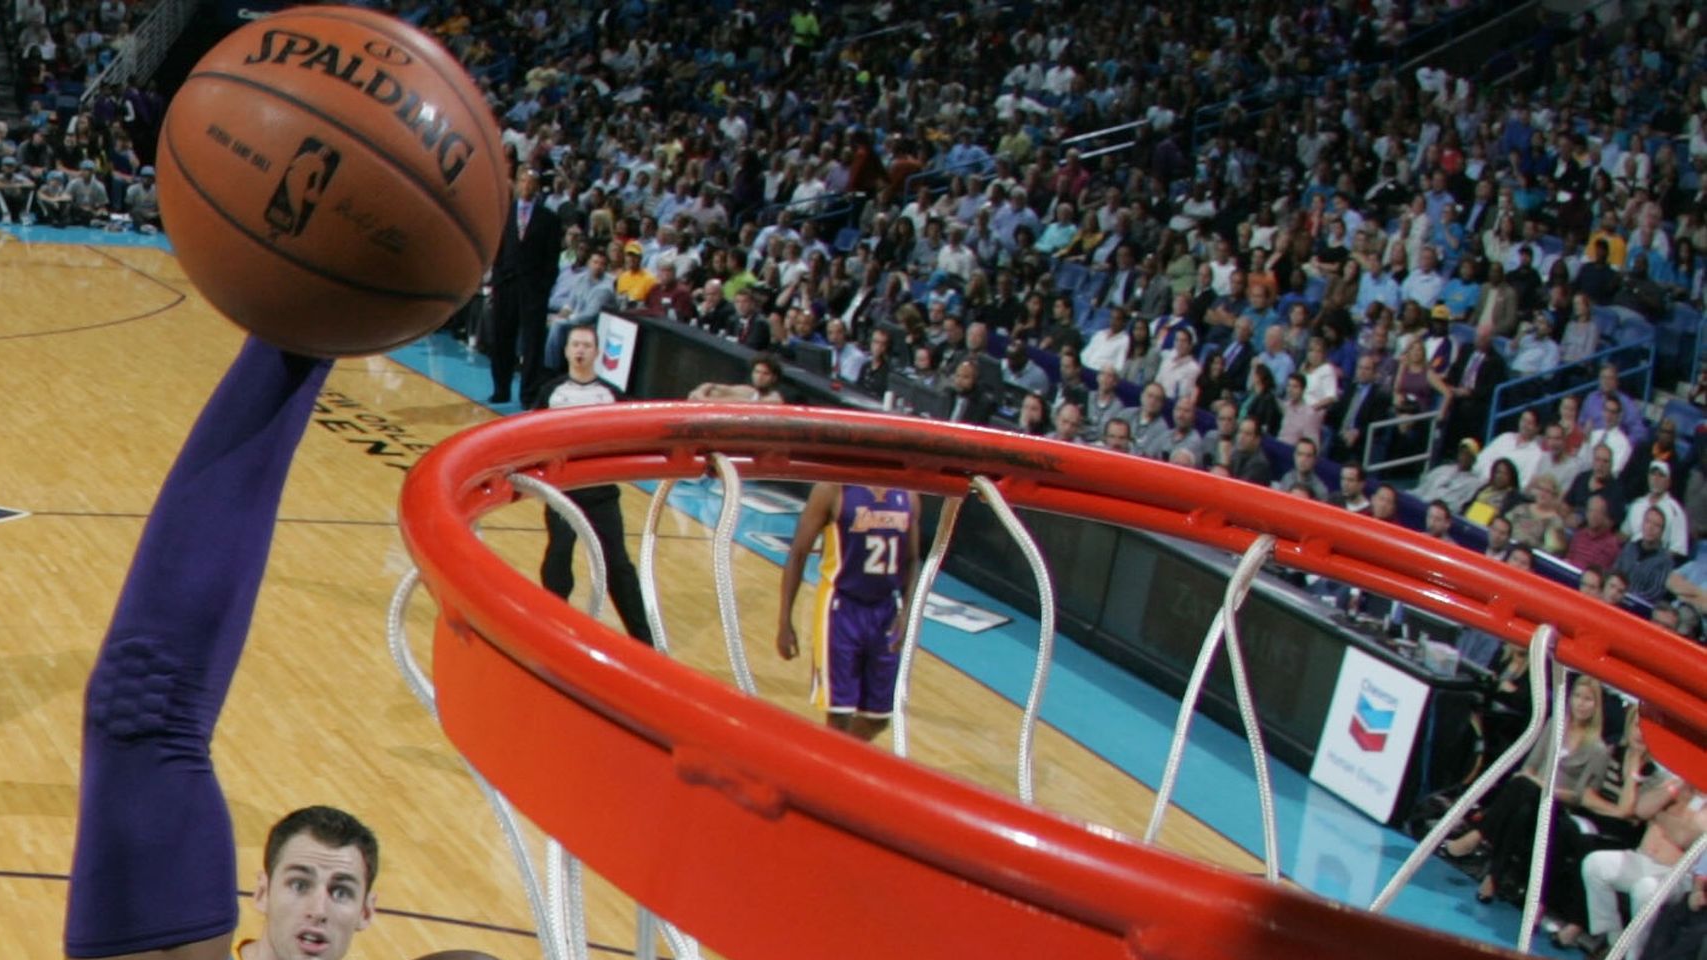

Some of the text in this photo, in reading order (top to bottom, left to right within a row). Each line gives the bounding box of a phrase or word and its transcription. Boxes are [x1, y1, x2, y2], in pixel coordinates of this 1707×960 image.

[243, 30, 474, 187] SPALDING
[355, 413, 435, 456] ORLE
[849, 506, 910, 532] LAKERS
[863, 535, 899, 575] 21
